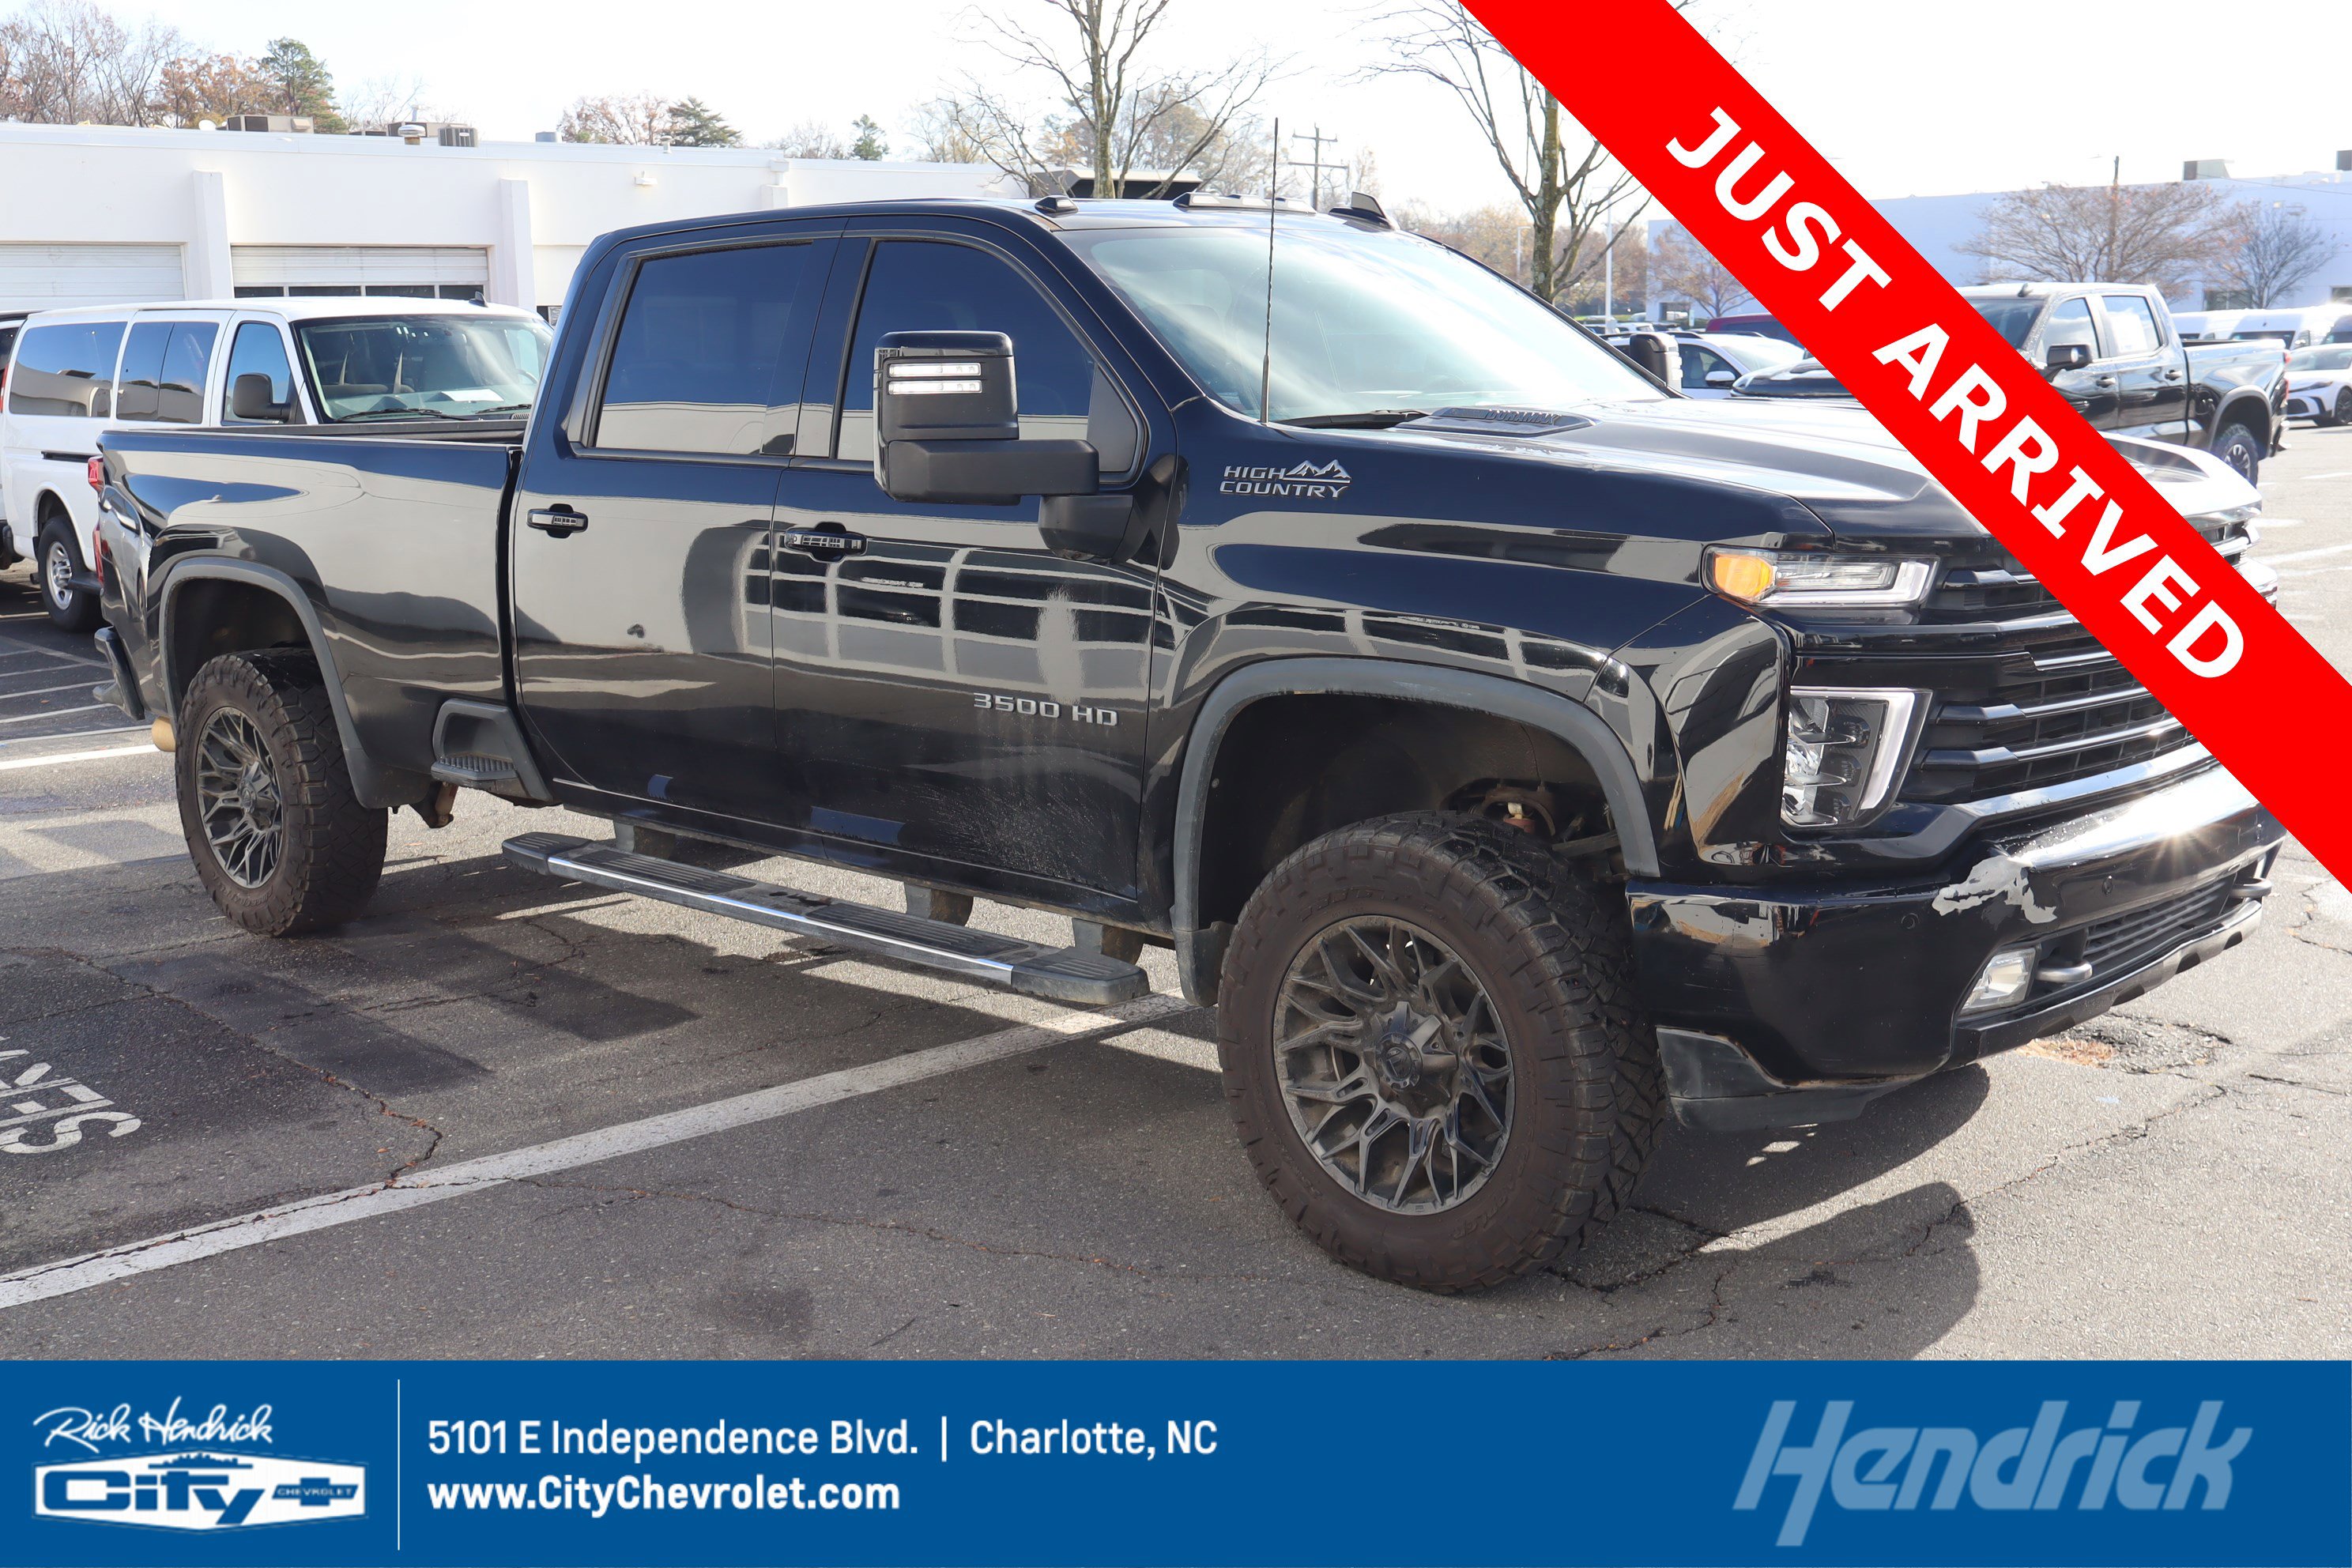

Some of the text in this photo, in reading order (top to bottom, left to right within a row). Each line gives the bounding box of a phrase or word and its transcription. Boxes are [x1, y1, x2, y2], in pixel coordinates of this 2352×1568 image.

[1484, 409, 1559, 424] DURAMAX
[1224, 466, 1287, 479] HIGH
[1219, 481, 1348, 498] COUNTRY
[973, 692, 1118, 726] 3500 HD
